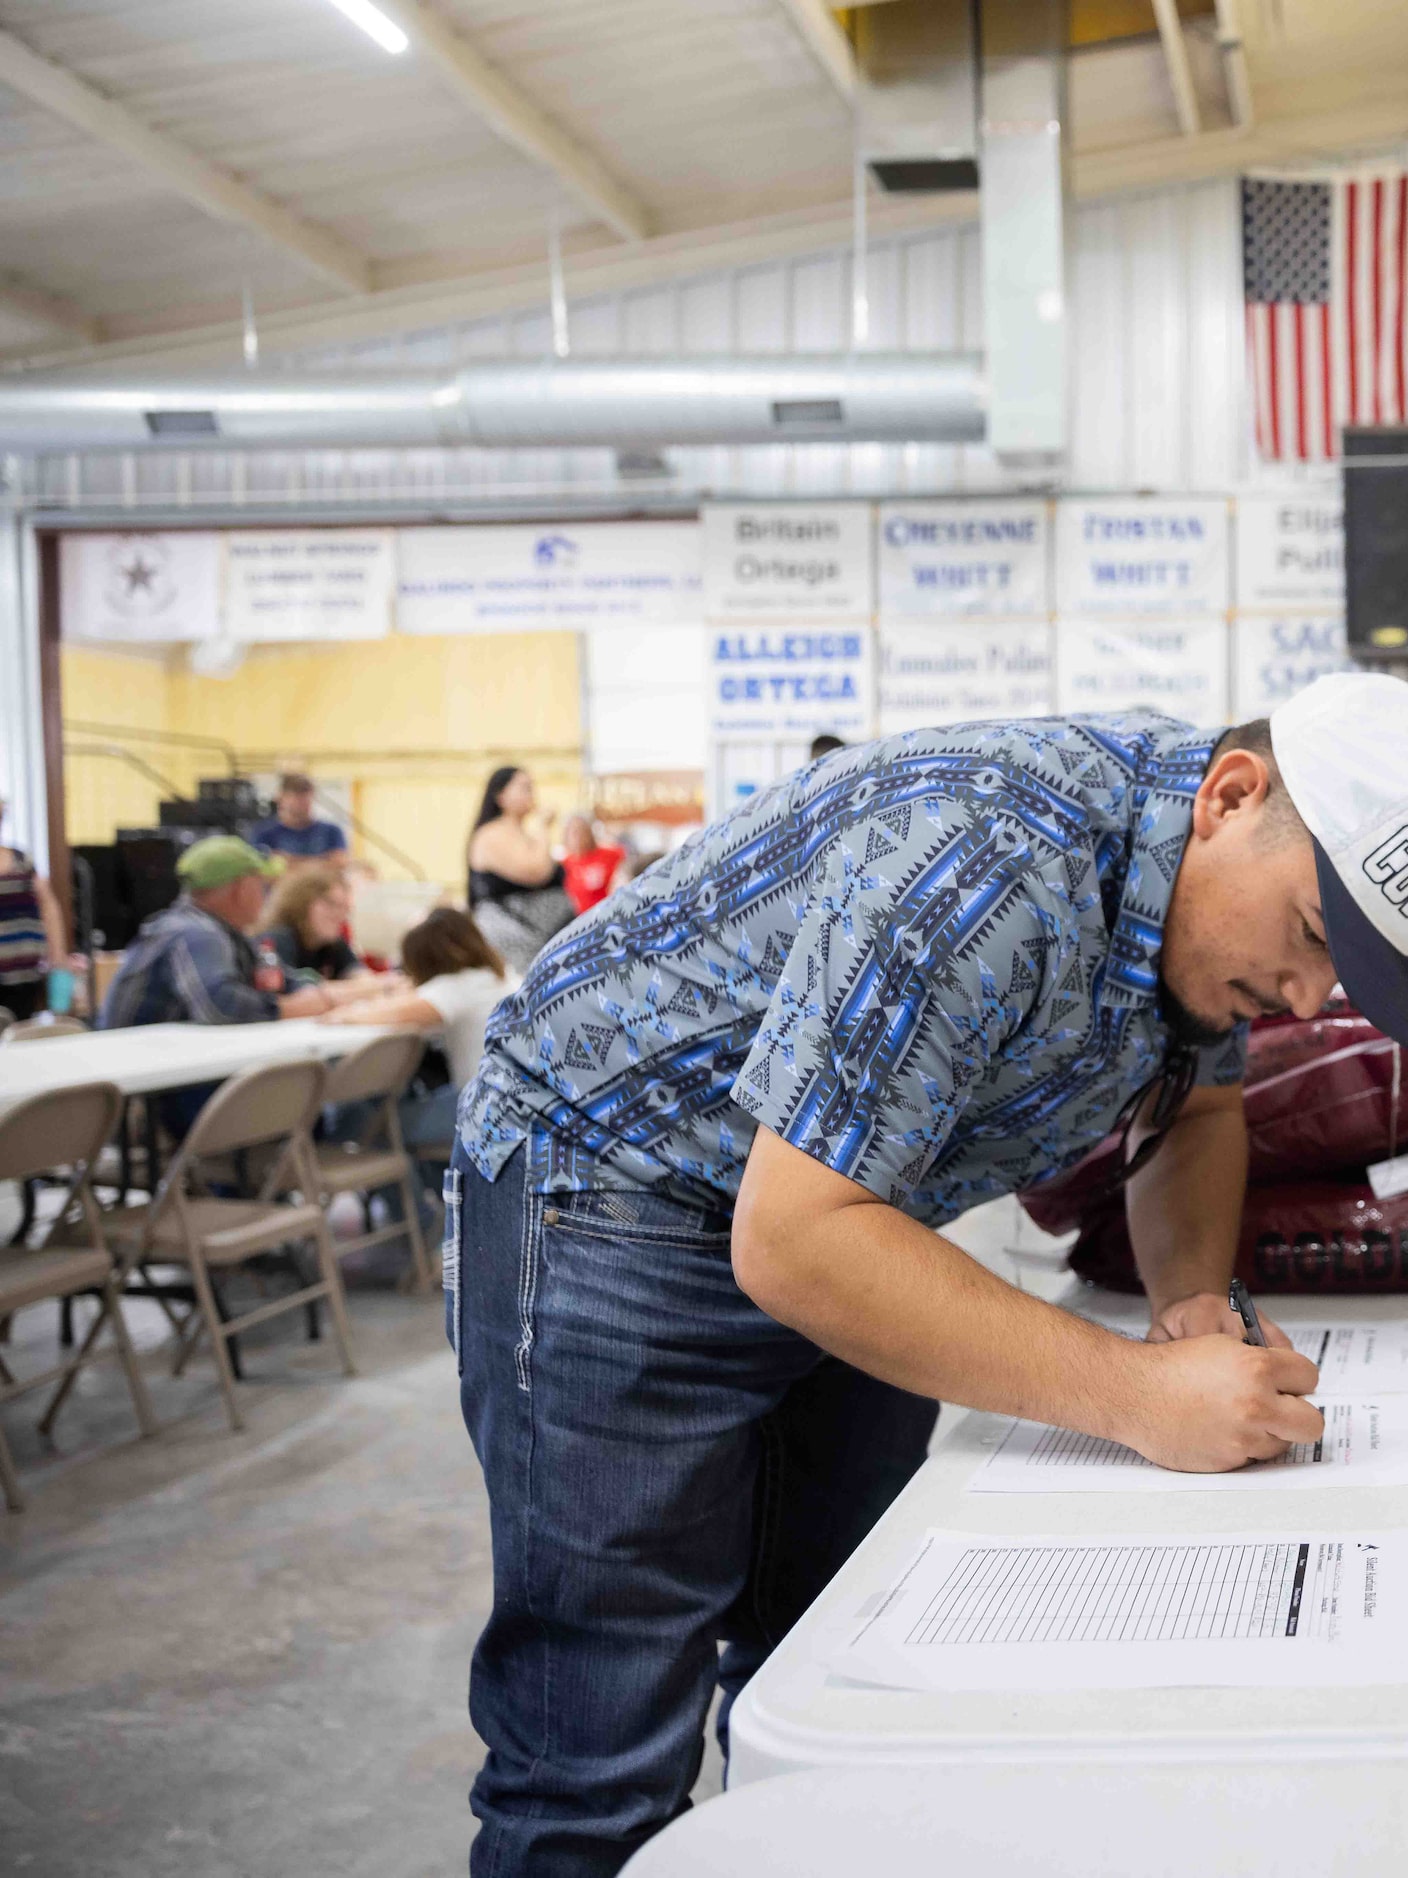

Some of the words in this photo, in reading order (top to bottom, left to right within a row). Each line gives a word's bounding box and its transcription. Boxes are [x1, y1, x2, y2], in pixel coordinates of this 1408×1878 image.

[718, 675, 857, 703] ORTEGA
[1366, 1557, 1378, 1571] Silent
[1365, 1572, 1377, 1592] Auction
[1364, 1592, 1376, 1601] Bid
[1363, 1602, 1376, 1618] Sheet
